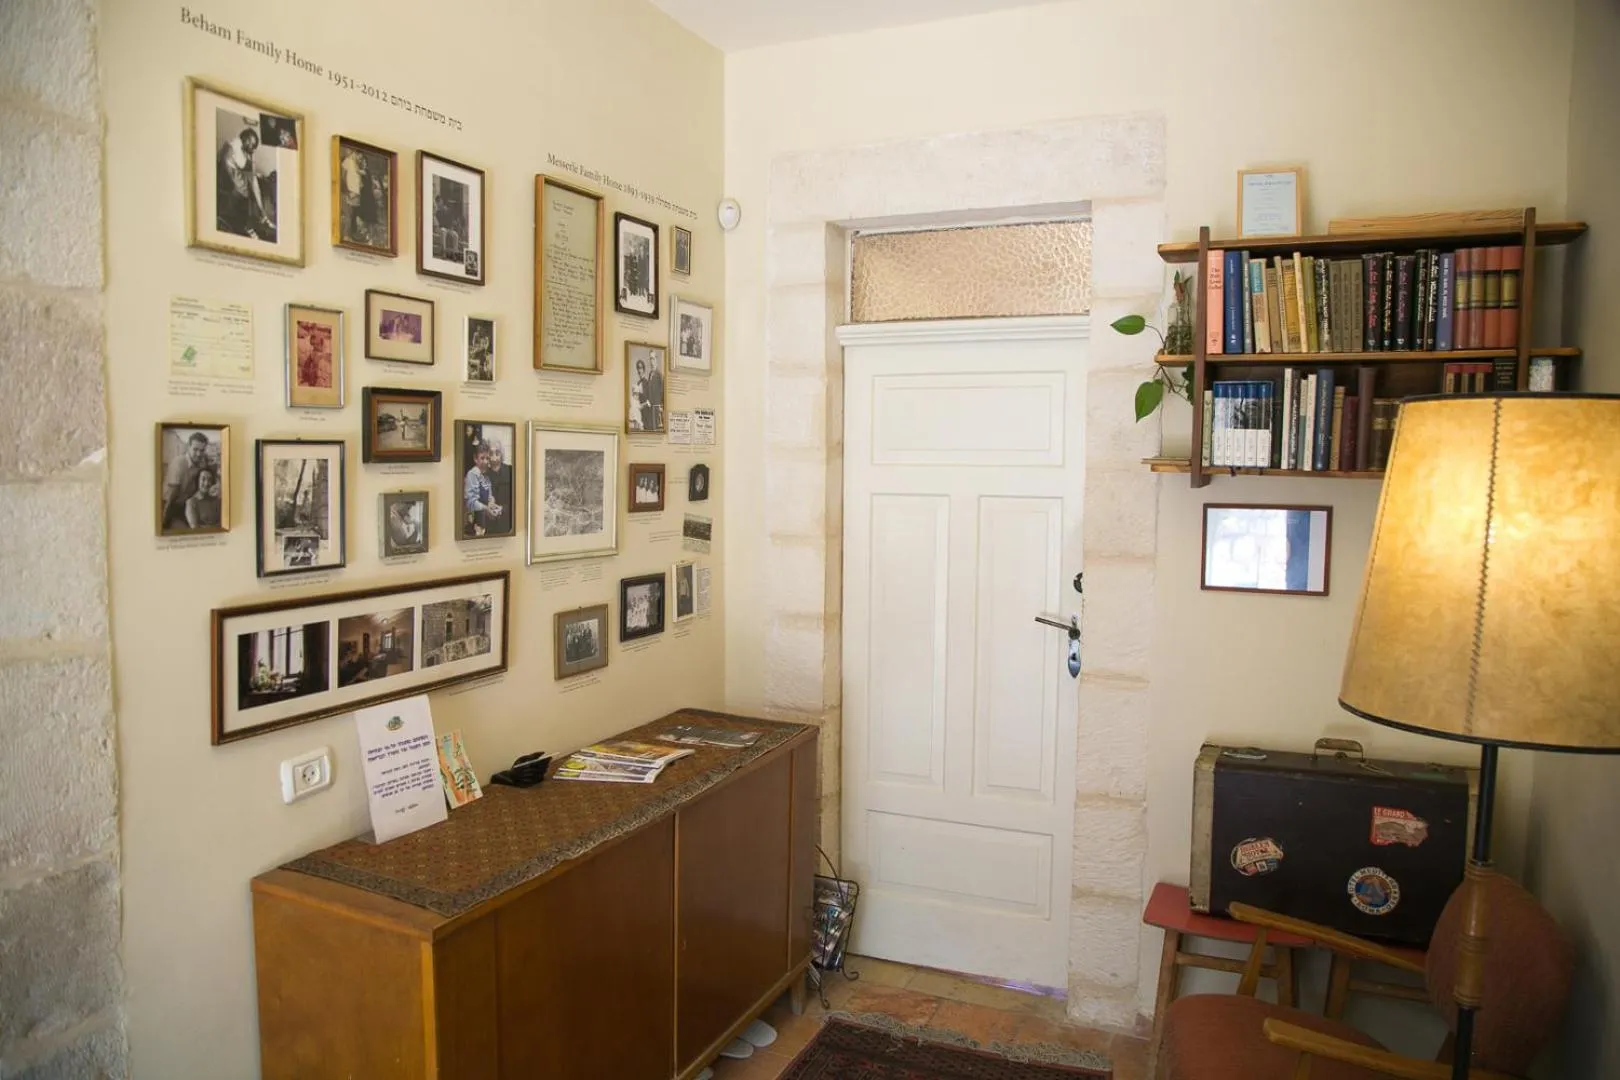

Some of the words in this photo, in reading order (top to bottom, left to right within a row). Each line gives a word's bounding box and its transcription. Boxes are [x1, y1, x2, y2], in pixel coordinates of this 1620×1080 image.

[179, 6, 232, 41] Beham
[235, 29, 282, 64] Family
[285, 48, 324, 76] Home
[327, 69, 388, 103] 1951-2012
[414, 104, 447, 125] משפחת
[448, 116, 463, 132] בית
[580, 165, 602, 184] Family
[603, 174, 623, 191] Home
